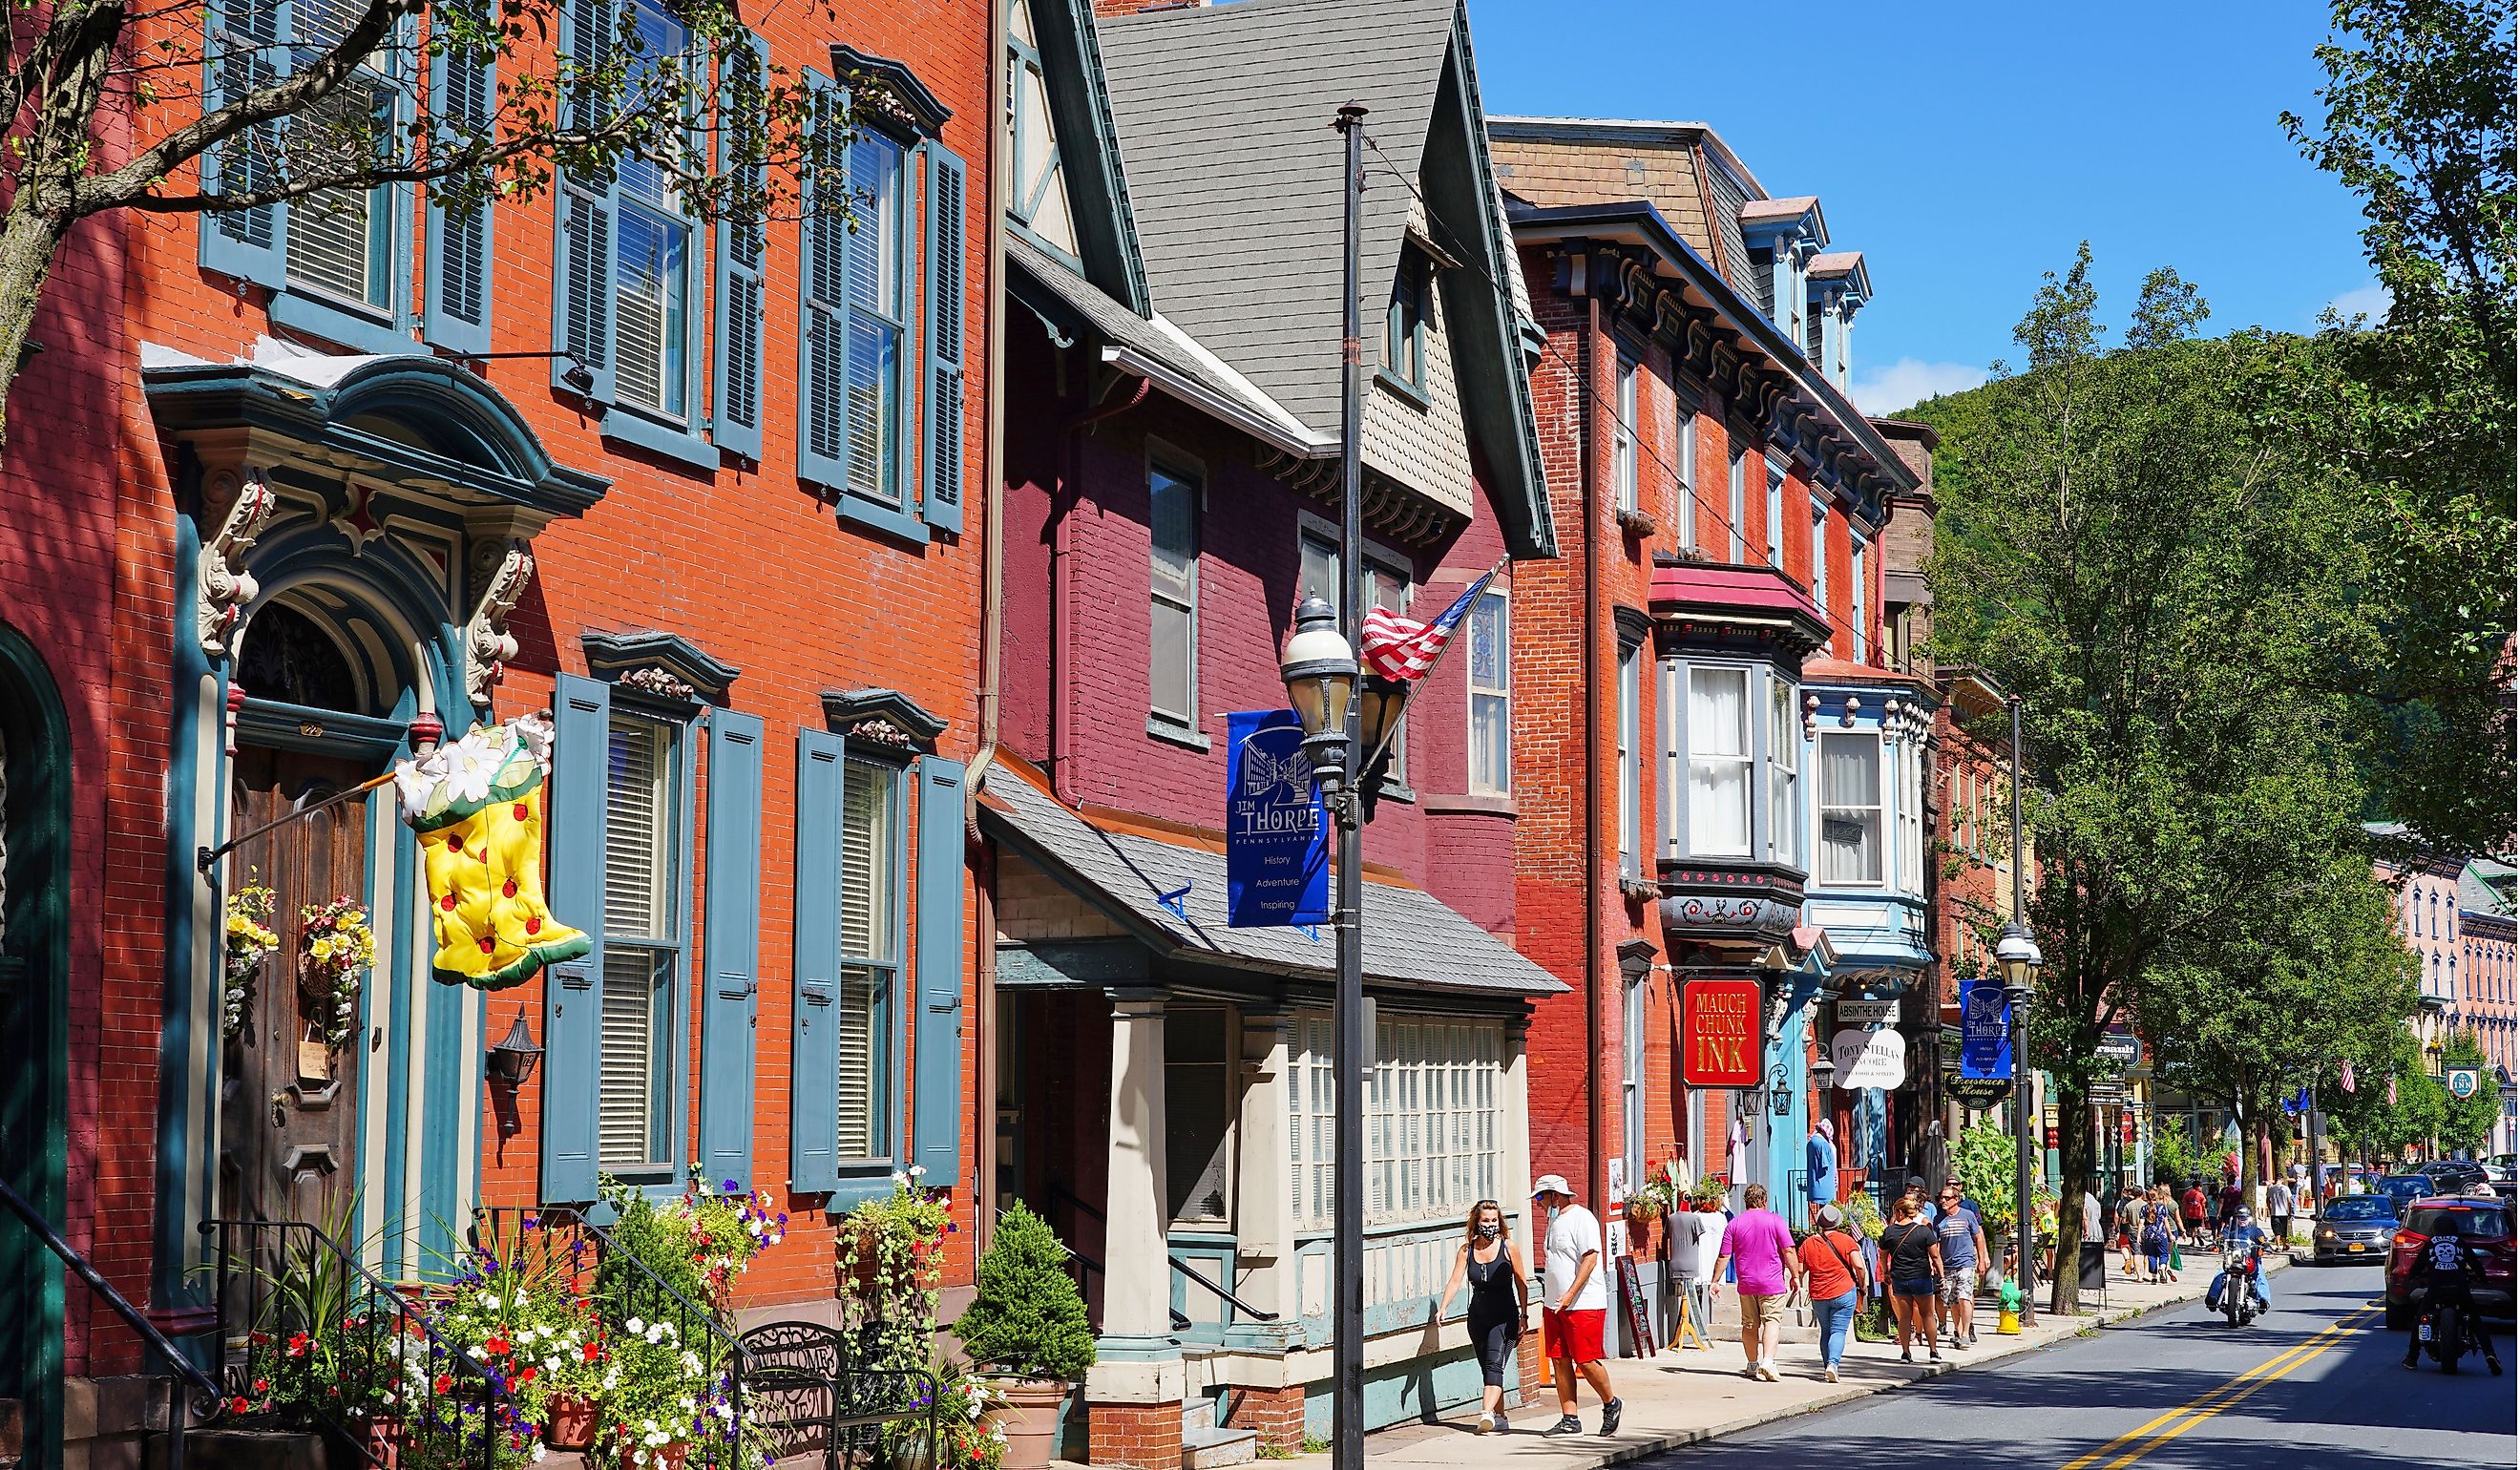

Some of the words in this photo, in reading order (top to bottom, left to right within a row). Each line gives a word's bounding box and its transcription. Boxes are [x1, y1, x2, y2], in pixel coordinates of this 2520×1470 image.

[1235, 800, 1255, 813] JIM
[1241, 802, 1319, 836] THORPE
[1236, 835, 1318, 845] PENNSYLVANIA
[1264, 856, 1291, 865] History
[1256, 878, 1299, 888] Adventure
[1260, 900, 1295, 911] Inspiring
[1696, 994, 1747, 1013] MAUCH
[1839, 1005, 1872, 1018] ABSINTHE
[1874, 1005, 1896, 1018] HOUSE
[1695, 1015, 1747, 1034] CHUNK
[1968, 1021, 2007, 1038] THORPE
[1696, 1037, 1747, 1072] INK
[1838, 1044, 1860, 1060] TONY
[2094, 1044, 2135, 1054] rsault
[1851, 1057, 1887, 1066] ENCORE
[1958, 1084, 1995, 1096] House
